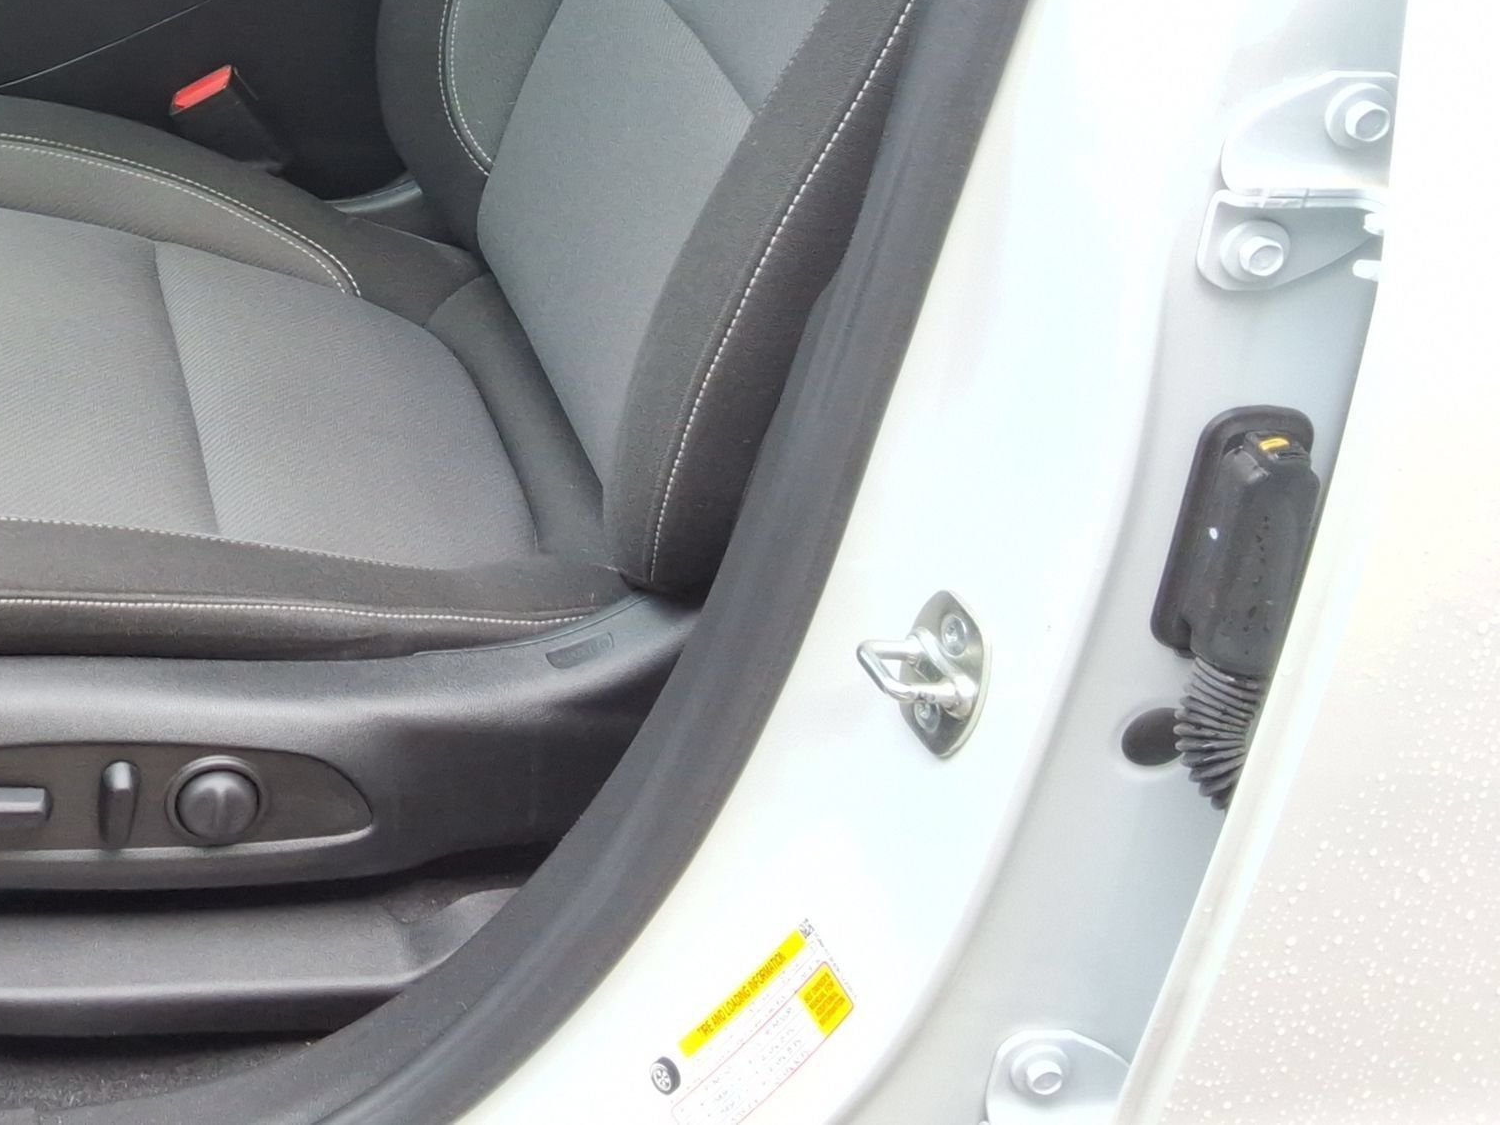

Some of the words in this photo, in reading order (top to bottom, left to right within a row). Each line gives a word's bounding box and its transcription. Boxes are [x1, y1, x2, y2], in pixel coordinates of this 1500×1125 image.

[711, 1008, 727, 1028] AND
[722, 985, 752, 1016] LOADING
[747, 951, 787, 993] INFORMATION
